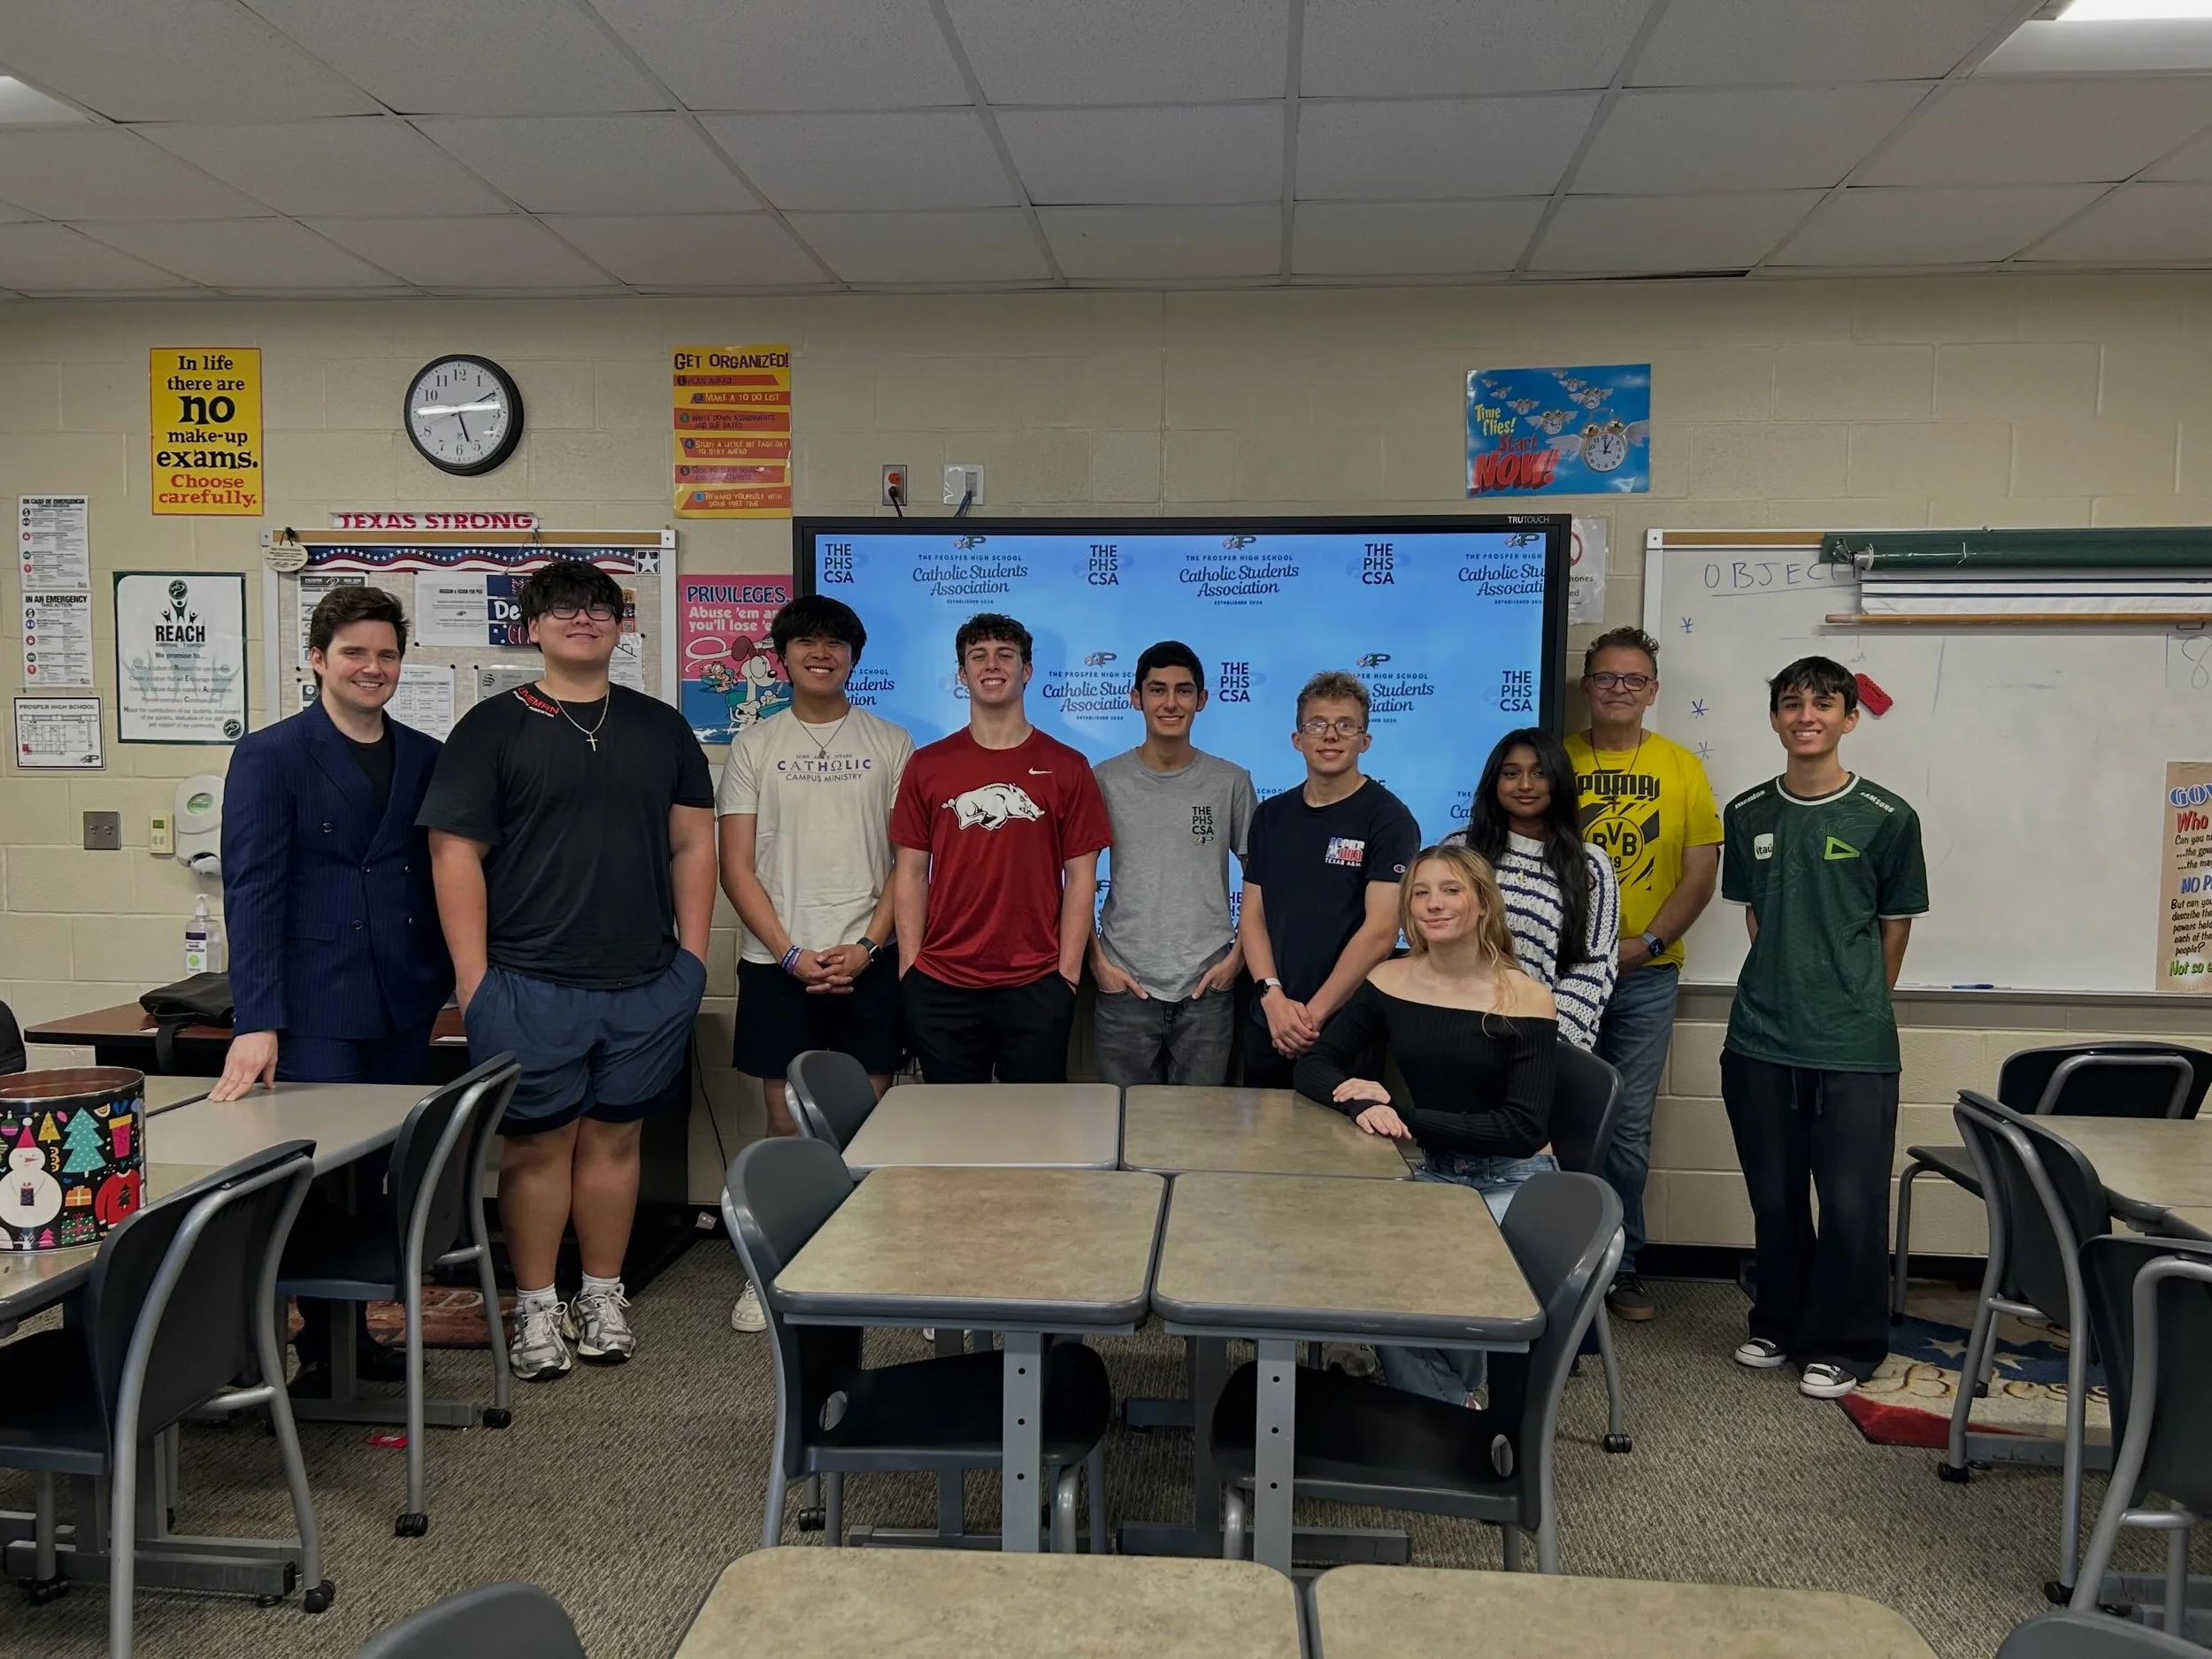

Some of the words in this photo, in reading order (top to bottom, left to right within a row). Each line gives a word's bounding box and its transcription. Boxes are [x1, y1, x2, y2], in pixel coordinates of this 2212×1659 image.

[178, 356, 197, 371] In
[203, 355, 234, 370] life
[675, 353, 702, 370] GET
[709, 353, 789, 369] ORGANIZED!
[436, 375, 448, 387] 11
[454, 369, 466, 381] 12
[477, 375, 481, 387] 1
[167, 376, 212, 390] there
[217, 379, 245, 390] are
[425, 389, 438, 401] 10
[706, 394, 726, 403] MAKE
[177, 396, 235, 425] no
[1474, 403, 1501, 420] Time
[1483, 418, 1516, 436] flies!
[167, 428, 248, 447] make-up
[456, 444, 463, 456] 6
[157, 449, 258, 469] exams.
[1471, 449, 1561, 491] NOW!
[171, 474, 245, 488] Choose
[159, 489, 257, 509] carefully.
[338, 514, 417, 528] TEXAS
[425, 514, 533, 528] STRONG
[825, 543, 851, 556] THE
[1090, 545, 1117, 557] THE
[1364, 543, 1394, 557] THE
[825, 557, 852, 569] PHS
[1089, 559, 1118, 572] PHS
[1363, 557, 1394, 571] PHS
[824, 571, 854, 583] CSA
[912, 565, 968, 581] Catholic
[970, 562, 1028, 580] Students
[1179, 565, 1236, 583] Catholic
[1239, 563, 1299, 580] Students
[1362, 571, 1395, 585] CSA
[1458, 564, 1520, 581] Catholic
[1087, 572, 1119, 586] CSA
[930, 580, 1010, 596] Association
[1197, 580, 1280, 597] Association
[494, 601, 523, 619] De
[689, 606, 732, 619] Abuse
[764, 610, 779, 618] an
[689, 619, 726, 633] you'll
[729, 620, 758, 631] lose
[762, 621, 772, 631] 'e
[156, 625, 205, 642] REACH
[1221, 662, 1249, 675] THE
[846, 676, 895, 692] tudents
[1220, 675, 1250, 688] PHS
[1502, 671, 1532, 684] THE
[954, 687, 970, 699] CS
[1042, 681, 1098, 698] Catholic
[1100, 679, 1132, 695] Stud
[1372, 680, 1435, 697] Students
[1502, 684, 1532, 698] PHS
[1219, 689, 1251, 703] CSA
[1369, 698, 1416, 713] iation
[1499, 698, 1533, 712] CSA
[786, 773, 822, 783] CAMPUS
[824, 772, 863, 783] MINISTRY
[1577, 773, 1655, 798] PUMA
[1191, 806, 1212, 815] THE
[1450, 804, 1472, 818] Ca
[1192, 816, 1213, 825] PHS
[2177, 810, 2209, 833] Who
[1191, 826, 1215, 834] CSA
[2175, 834, 2189, 845] Can
[2191, 835, 2204, 845] you
[2181, 877, 2200, 894] NO
[2171, 898, 2185, 910] But
[2172, 910, 2200, 921] describe
[2173, 923, 2196, 934] powers
[2174, 933, 2190, 943] each
[2192, 932, 2200, 941] of
[2175, 941, 2206, 956] people?
[2170, 960, 2189, 977] Not
[2192, 963, 2205, 974] so
